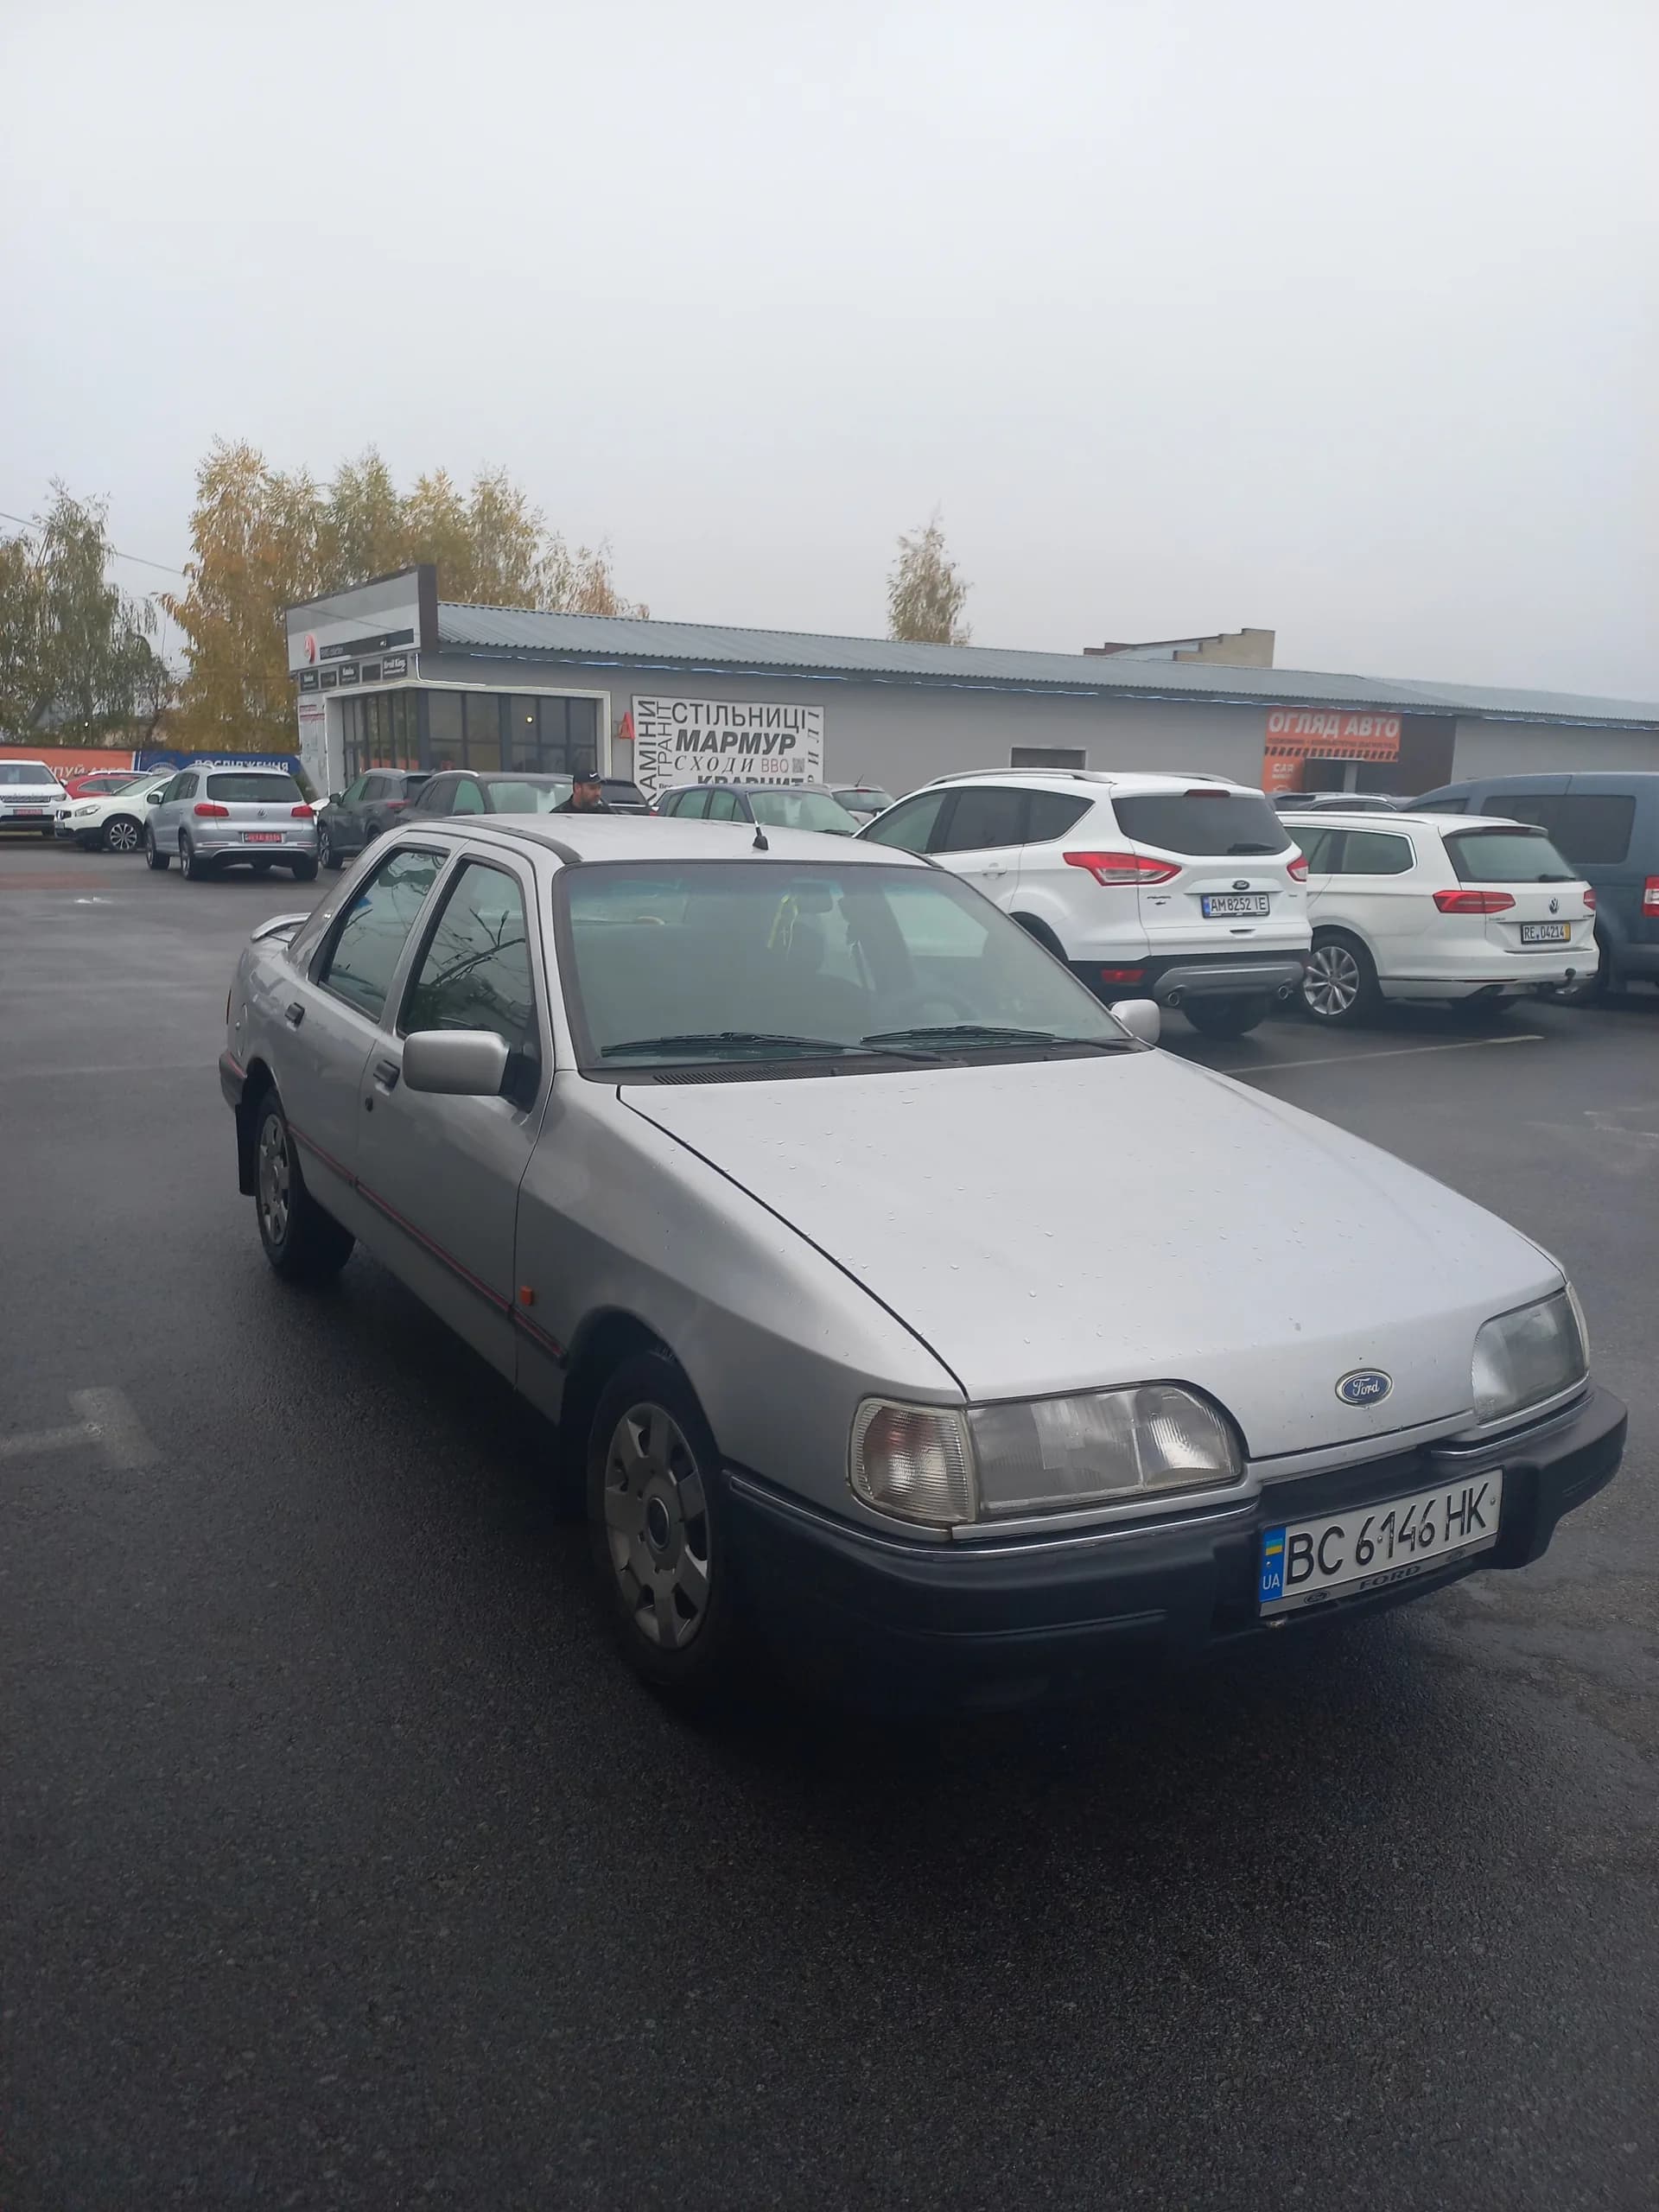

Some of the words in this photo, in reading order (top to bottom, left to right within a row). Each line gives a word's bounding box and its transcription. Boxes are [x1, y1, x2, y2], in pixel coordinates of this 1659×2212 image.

[671, 702, 806, 734] СТІЛЬНИЦІ
[1268, 711, 1341, 739] ОГЛЯД
[1344, 715, 1400, 738] АВТО
[656, 701, 673, 777] ГРАНІТ
[675, 728, 797, 756] МАРМУР
[674, 754, 754, 775] СХОДИ
[1227, 897, 1252, 911] 8252
[1524, 926, 1535, 939] RE
[1352, 1377, 1380, 1396] Ford
[1286, 1525, 1345, 1586] BC
[1355, 1498, 1437, 1567] 6146
[1444, 1481, 1490, 1542] HK
[1262, 1573, 1281, 1591] UA
[1358, 1565, 1421, 1591] FORD
